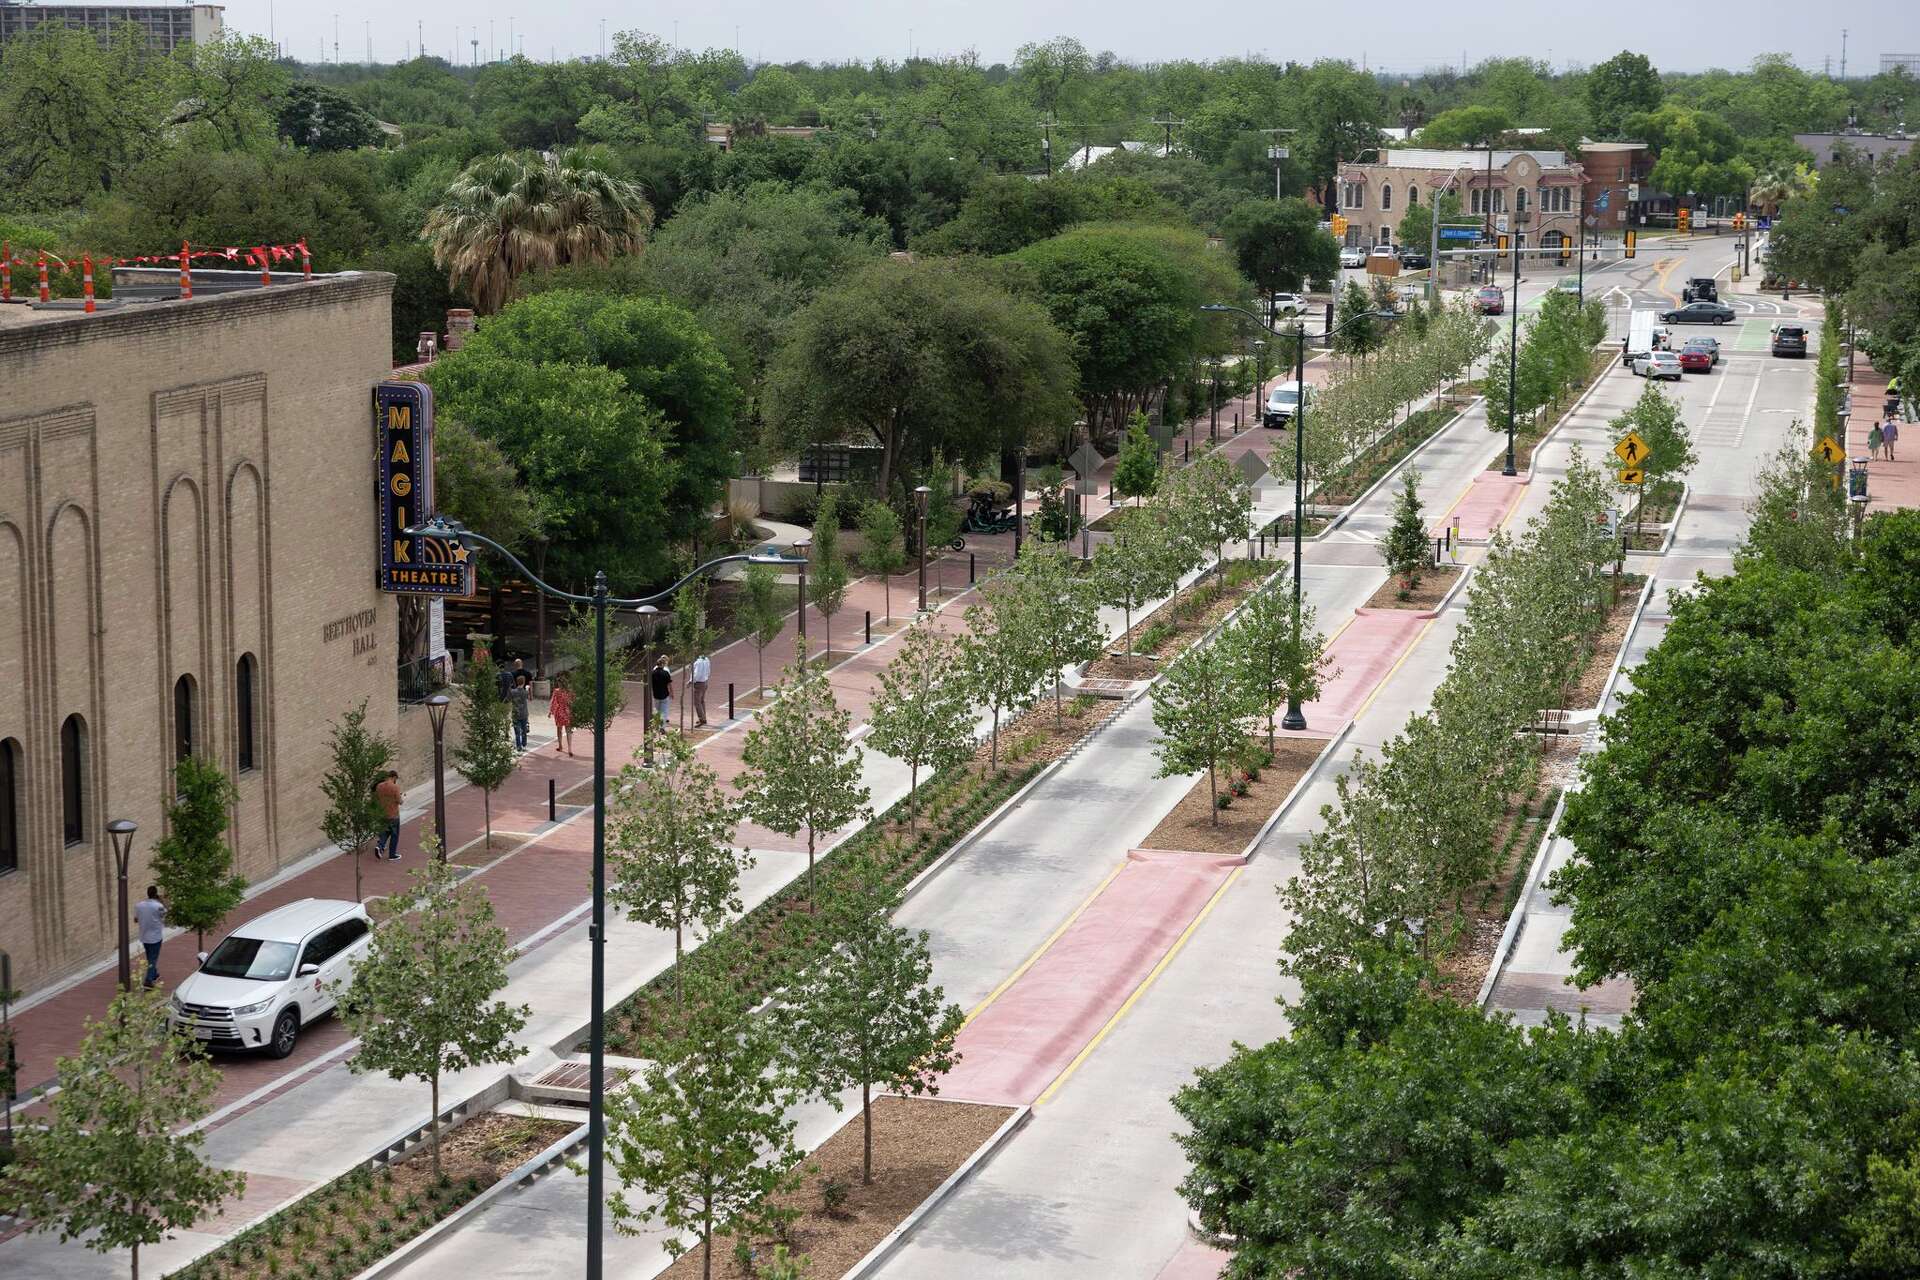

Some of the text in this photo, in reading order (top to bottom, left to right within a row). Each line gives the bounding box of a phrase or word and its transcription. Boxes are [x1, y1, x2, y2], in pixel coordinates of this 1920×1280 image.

[388, 406, 411, 563] MAGIK
[391, 570, 458, 585] THEATRE
[323, 607, 377, 643] BEETHOVEN
[352, 632, 378, 657] HALL
